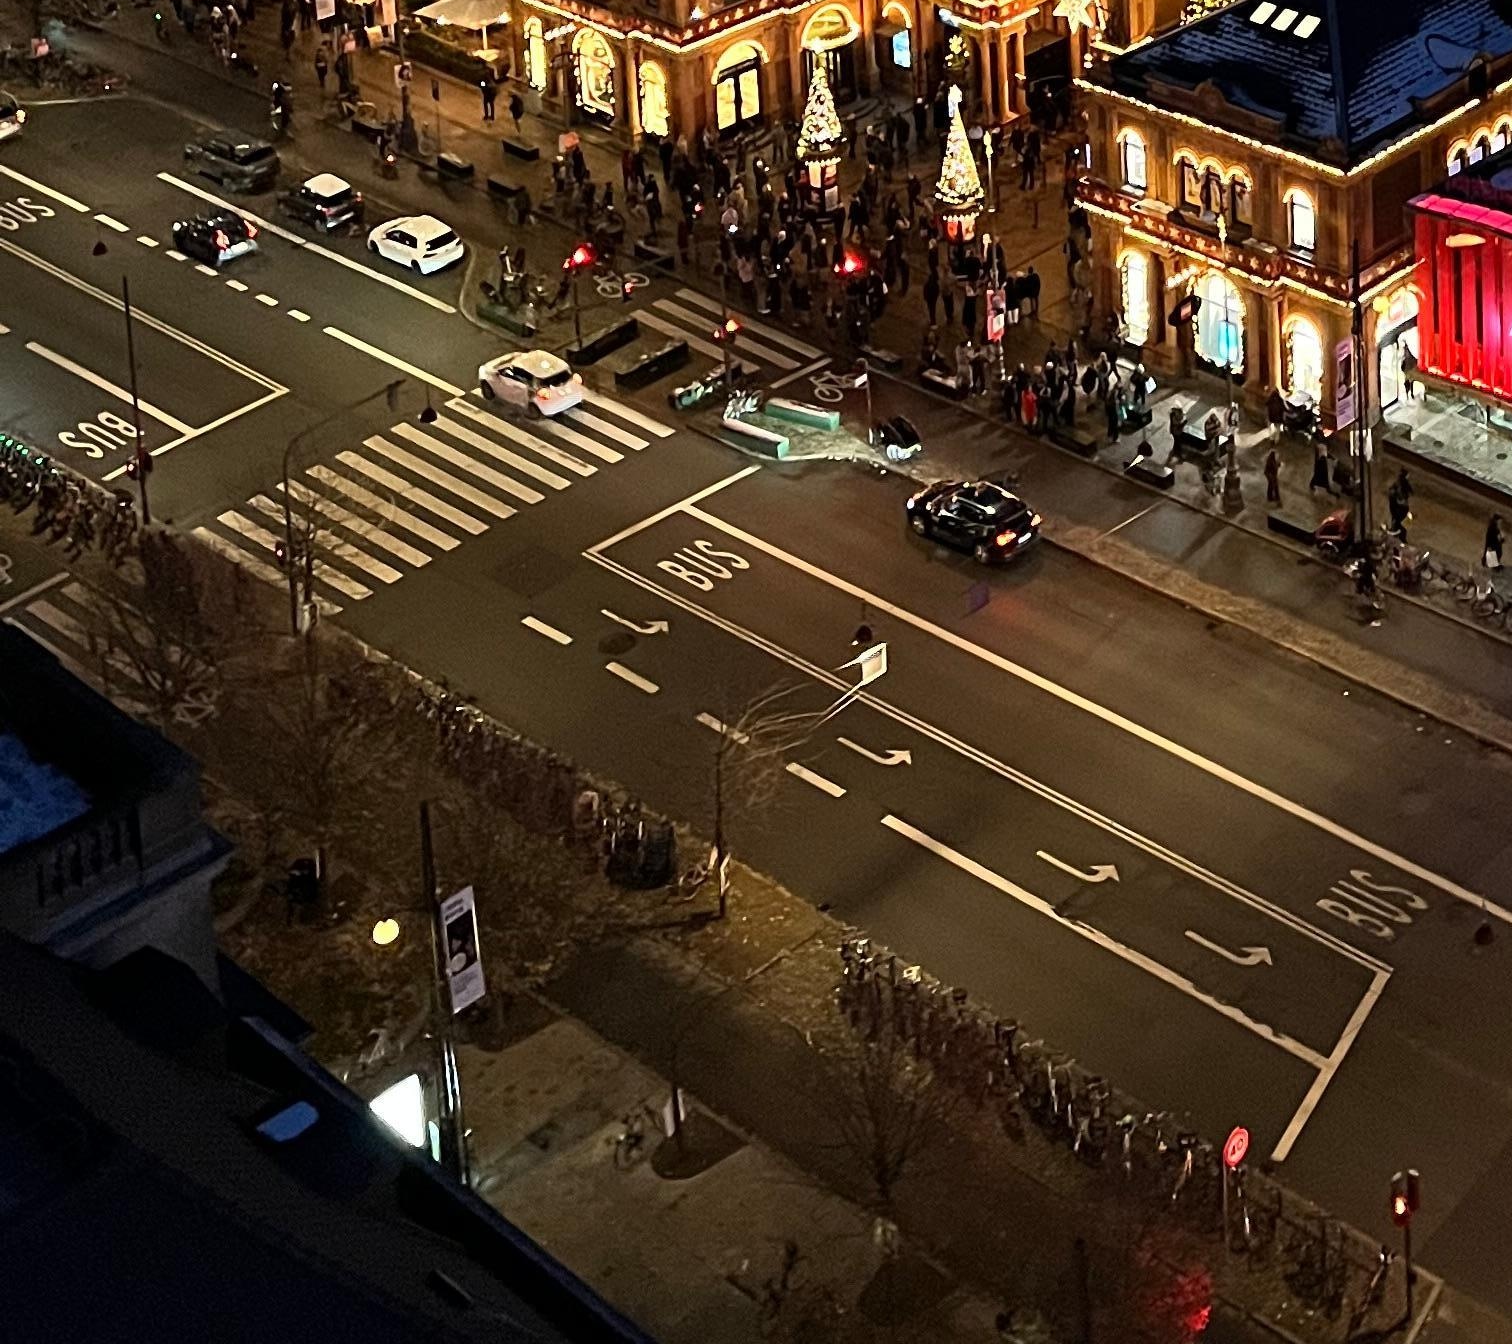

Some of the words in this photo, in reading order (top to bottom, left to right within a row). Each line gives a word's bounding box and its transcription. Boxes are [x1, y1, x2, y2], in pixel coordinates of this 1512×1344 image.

[58, 411, 144, 459] BUS
[656, 540, 750, 592] BUS
[1315, 869, 1429, 940] BUS
